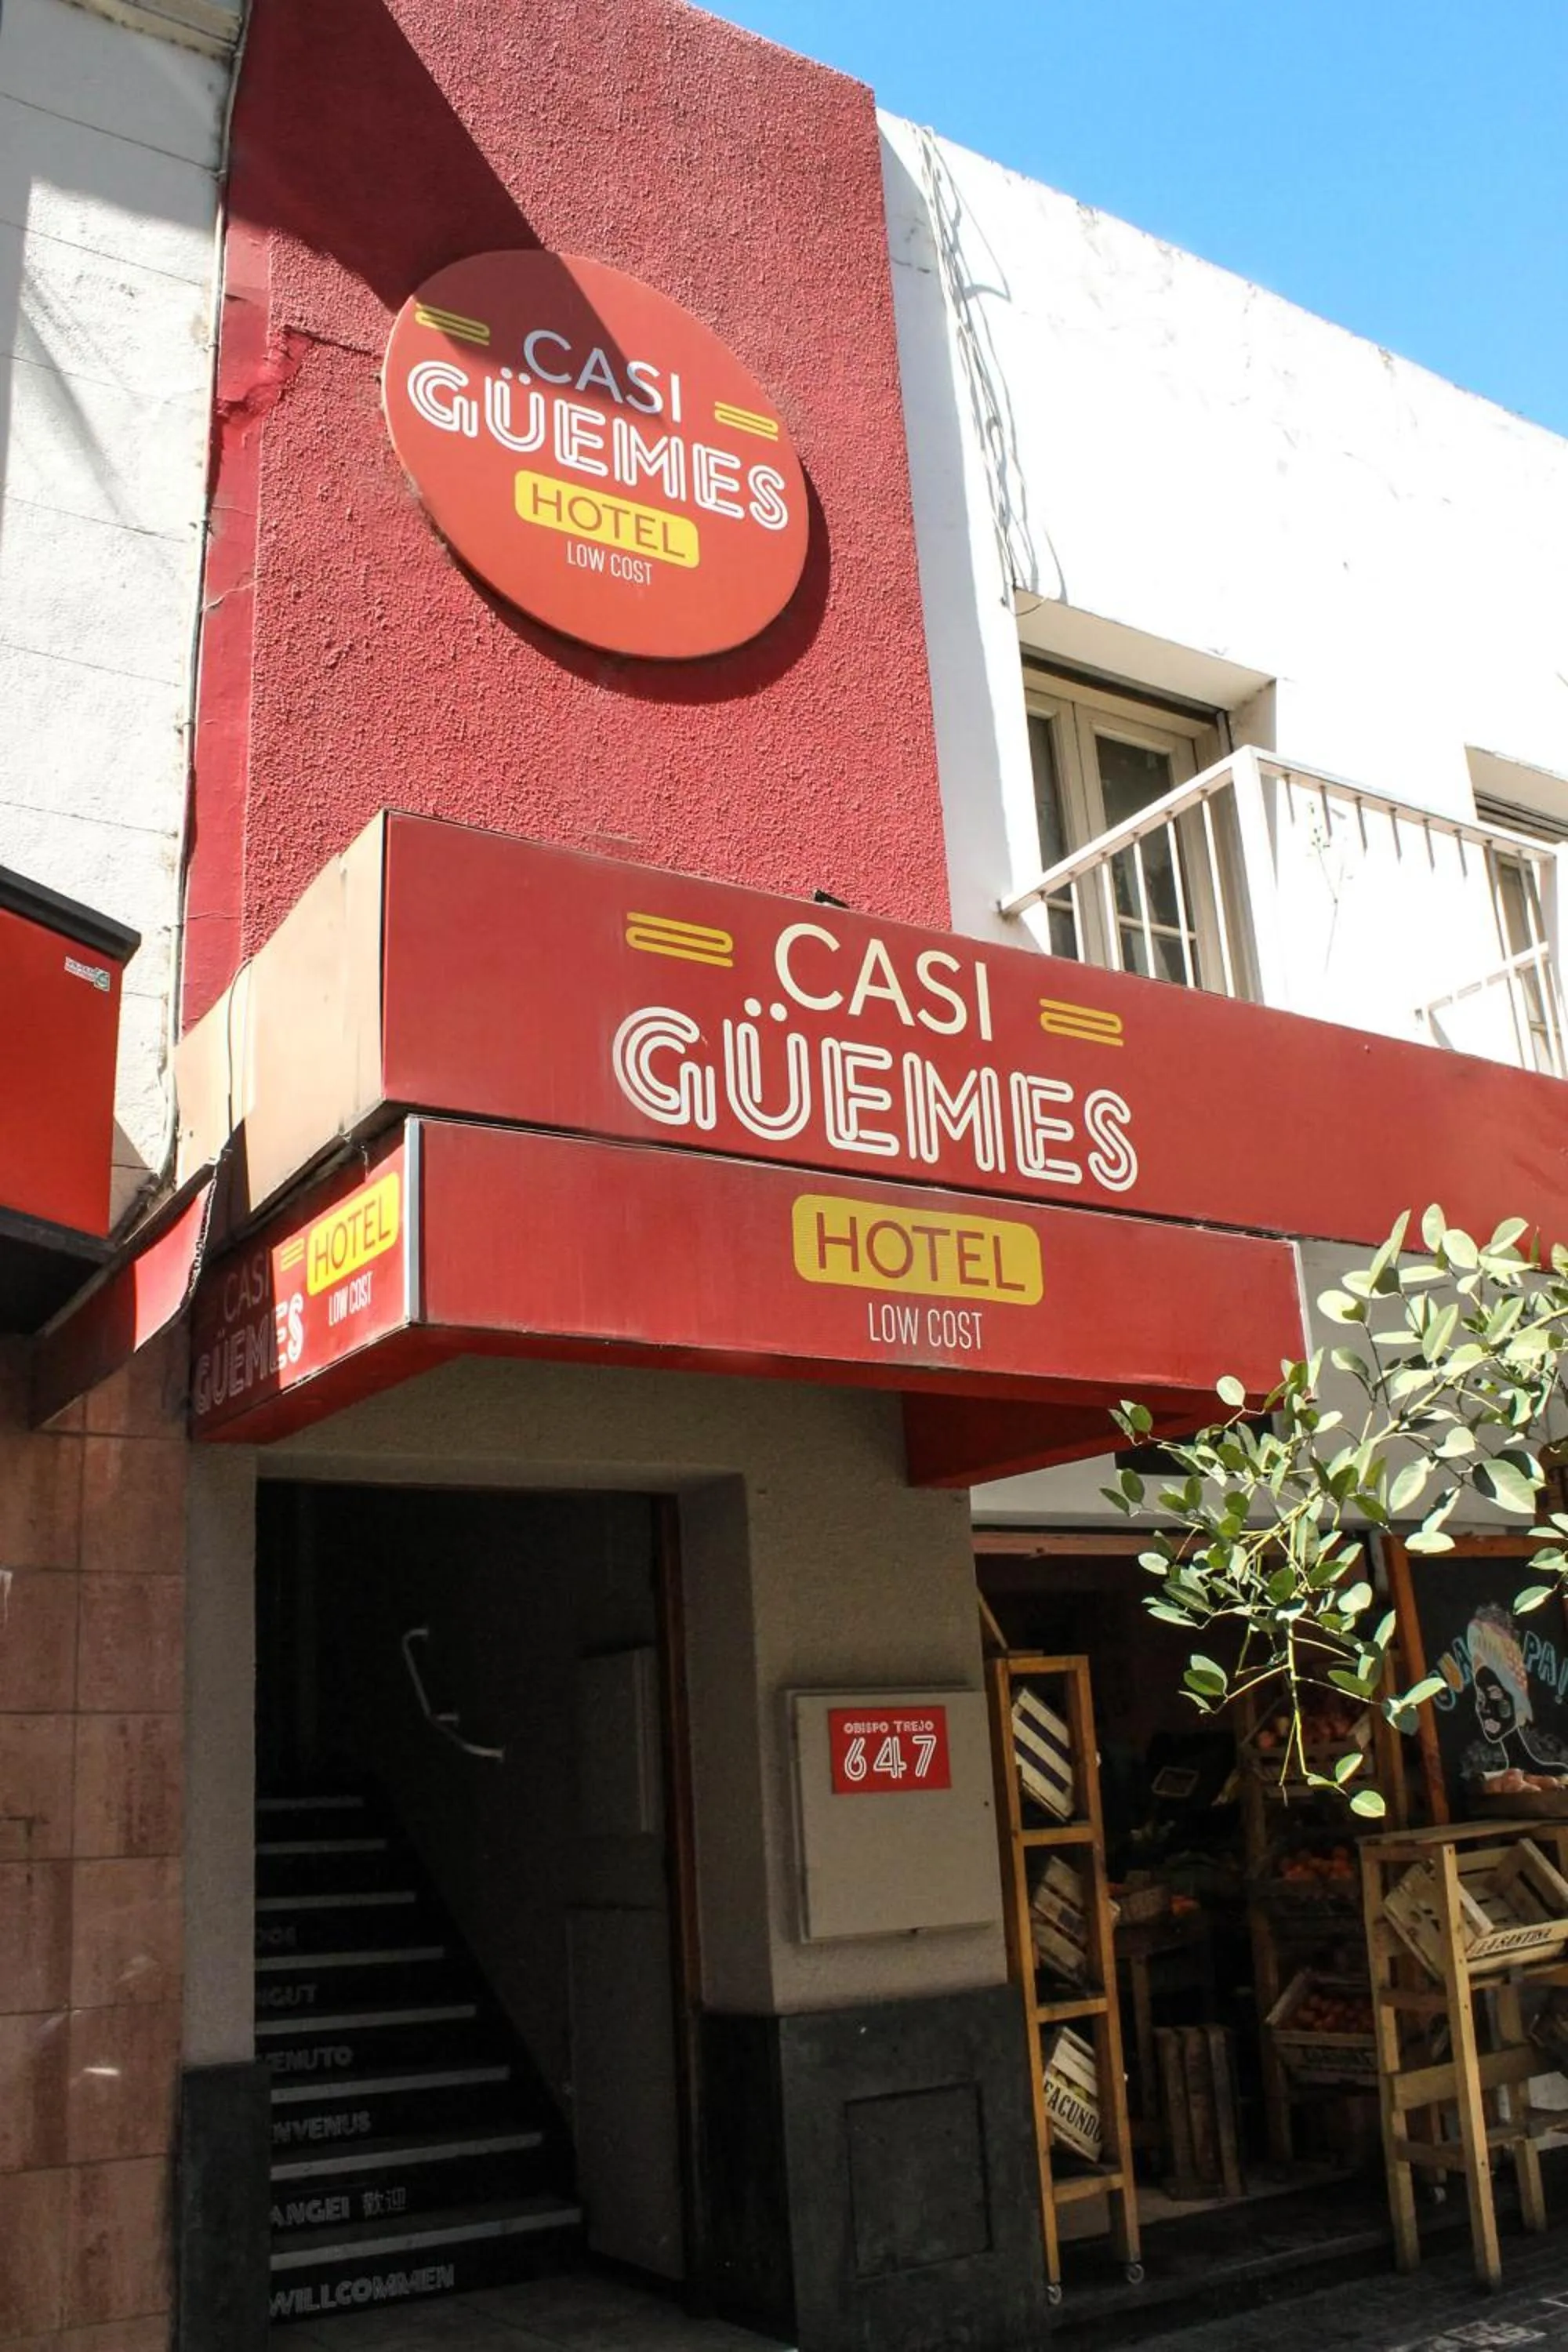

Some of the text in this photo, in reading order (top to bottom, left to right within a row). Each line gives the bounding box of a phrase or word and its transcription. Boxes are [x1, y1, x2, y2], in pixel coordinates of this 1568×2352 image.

[524, 330, 681, 423] CASI
[407, 361, 789, 531] GÜEMES
[532, 482, 686, 559] HOTEL
[566, 541, 653, 585] LOW COST
[775, 923, 993, 1041] CASI
[612, 998, 1138, 1192] GÜEMES
[313, 1195, 390, 1283] HOTEL
[816, 1211, 1025, 1293] HOTEL
[223, 1251, 270, 1321] CASI
[328, 1270, 373, 1327] LOW COST
[194, 1293, 303, 1414] GÜEMES
[868, 1302, 982, 1350] LOW COST
[844, 1720, 935, 1734] OBISPO TREJO
[844, 1734, 937, 1781] 647
